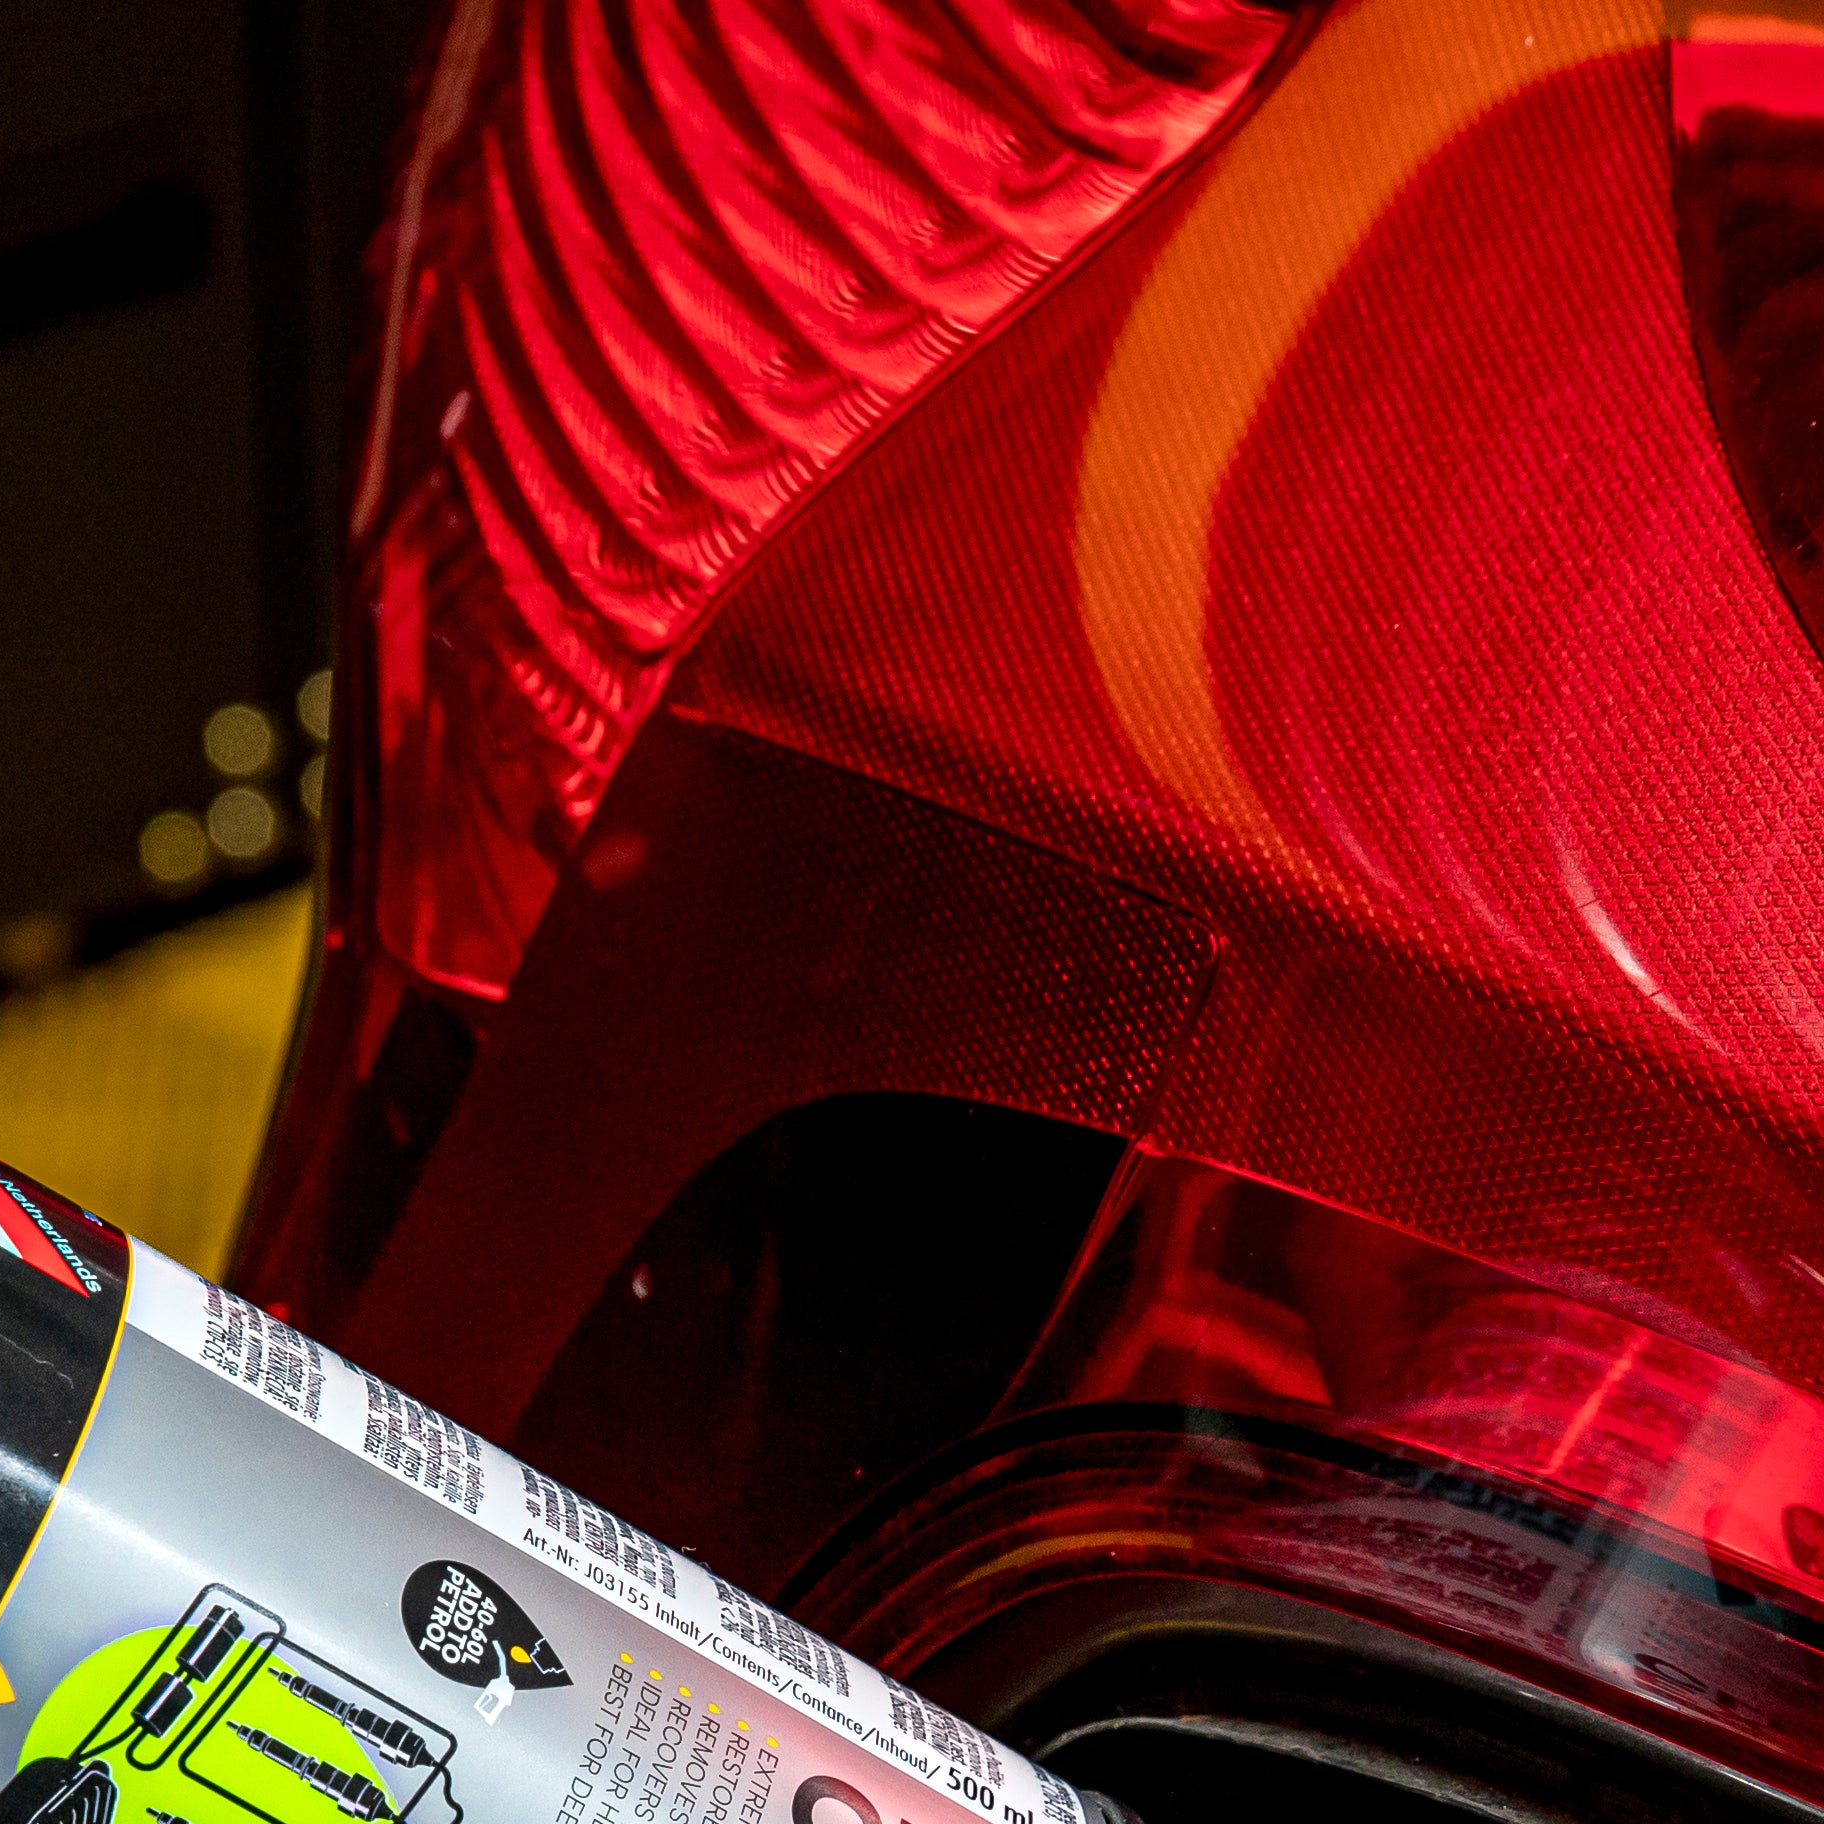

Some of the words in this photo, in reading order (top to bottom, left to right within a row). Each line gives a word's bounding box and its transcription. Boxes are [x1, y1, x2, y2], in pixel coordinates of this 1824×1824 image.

[420, 1566, 465, 1651] PETROL
[454, 1578, 482, 1631] ADD
[461, 1597, 497, 1664] 40-60L
[442, 1632, 467, 1663] TO
[585, 1563, 648, 1610] J03155
[947, 1767, 994, 1810] 500
[601, 1664, 632, 1724] BEST
[626, 1681, 662, 1741] IDEAL
[580, 1723, 614, 1775] FOR
[606, 1748, 640, 1799] FOR
[635, 1698, 691, 1821] RECOVERS
[670, 1715, 720, 1824] REMOVES
